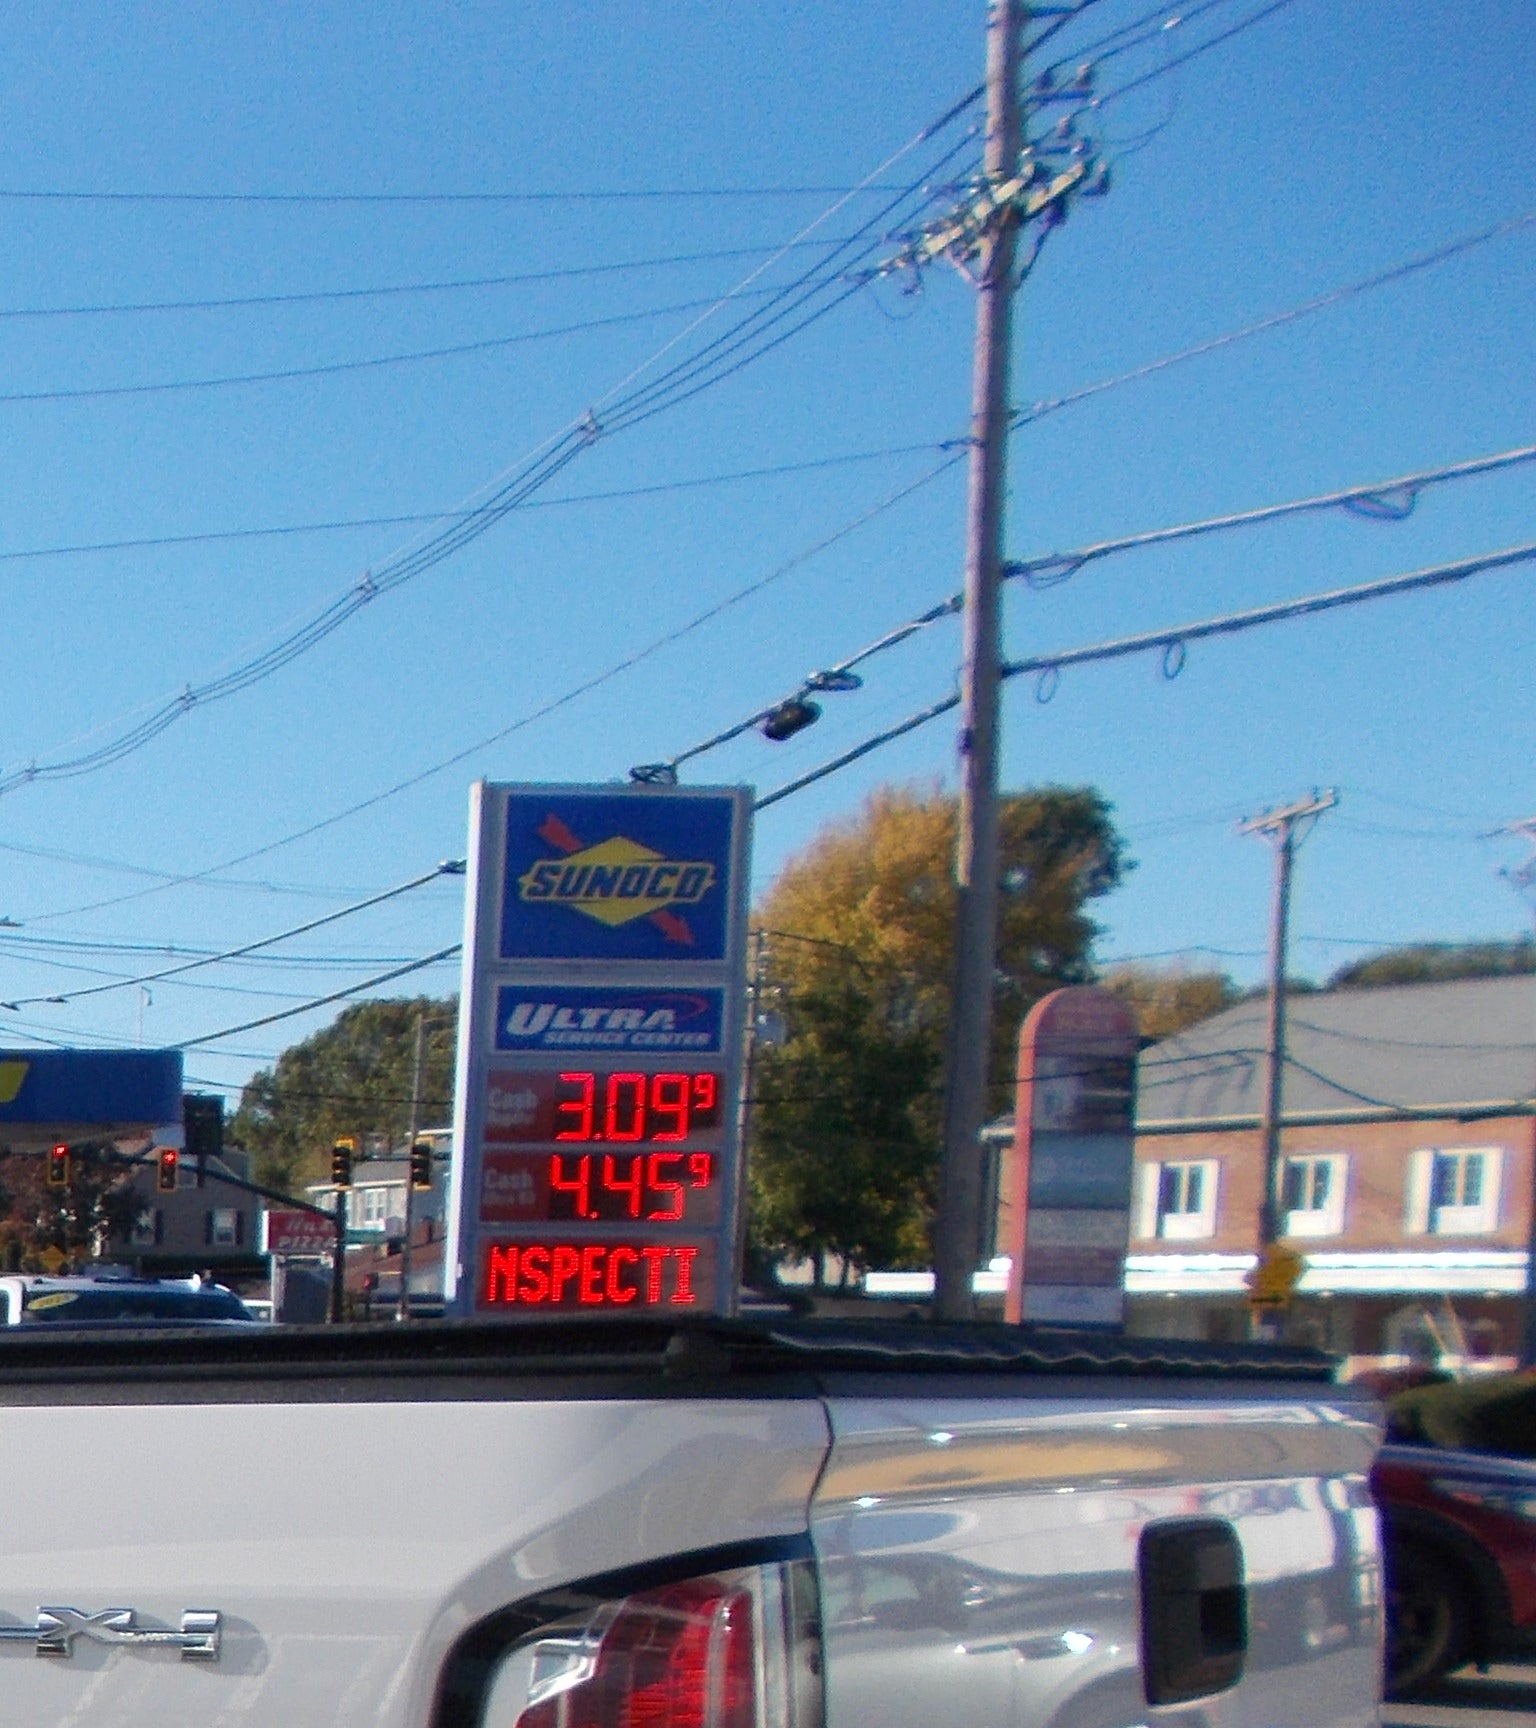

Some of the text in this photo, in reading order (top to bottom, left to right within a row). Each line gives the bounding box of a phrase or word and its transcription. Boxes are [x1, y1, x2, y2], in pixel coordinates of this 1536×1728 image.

[525, 864, 712, 899] SUNOCO
[506, 1003, 677, 1036] ULTRA
[543, 1032, 713, 1046] SERVICE CENTER
[488, 1246, 699, 1304] NSPECTI
